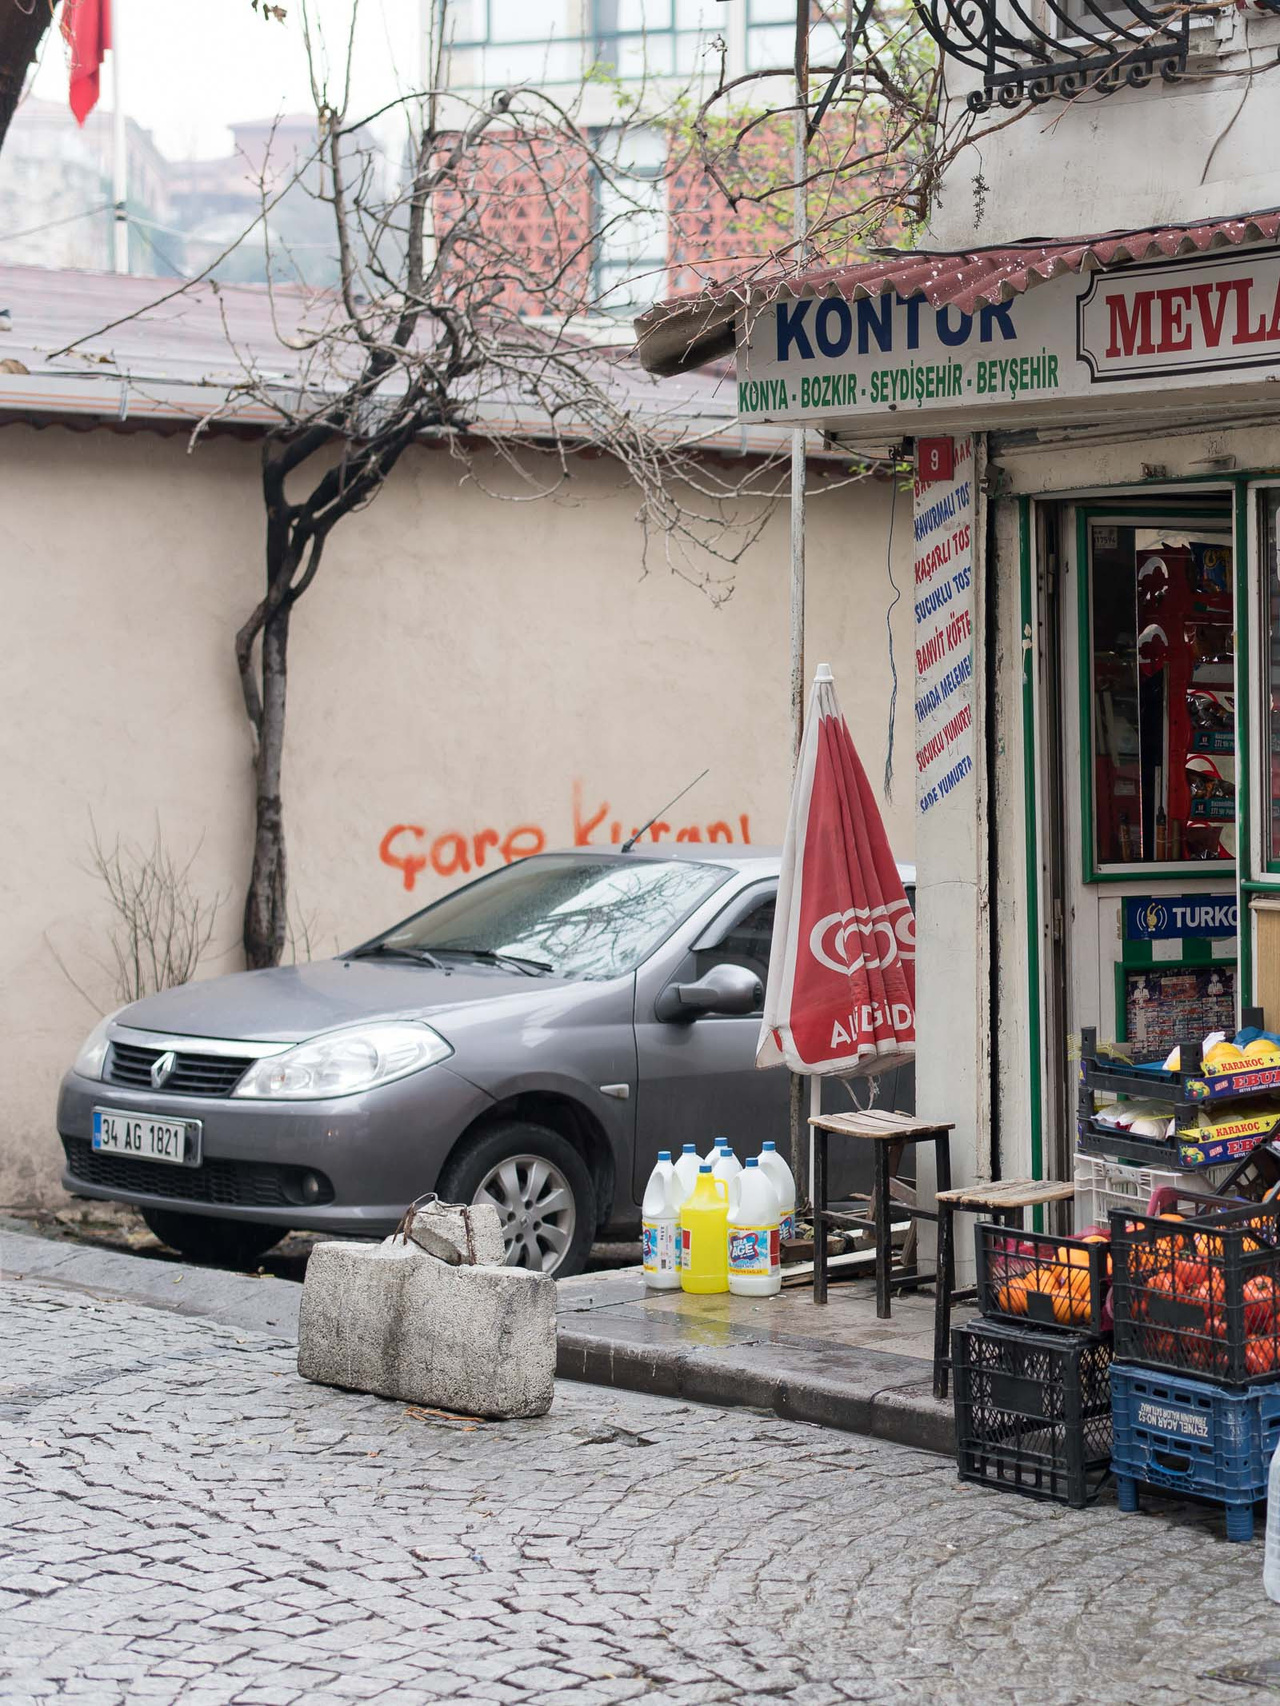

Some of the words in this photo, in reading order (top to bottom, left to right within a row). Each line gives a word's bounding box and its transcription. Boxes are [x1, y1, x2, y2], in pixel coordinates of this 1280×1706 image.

[739, 379, 788, 412] KONYA
[801, 372, 857, 408] BOZKIR
[870, 358, 963, 408] SEYDİŞEHİR
[977, 347, 1058, 399] BEYŞEHİR
[930, 449, 939, 471] 9
[914, 492, 956, 541] KAVURMALI
[956, 482, 971, 511] TOS
[914, 538, 951, 585] KAŞARLI
[952, 524, 971, 556] TOS
[915, 581, 953, 623] SUCUKLU
[915, 626, 946, 675] BANVİT
[914, 684, 943, 723] TAVADA
[915, 733, 945, 773] SUCUKLU
[920, 787, 939, 814] SADE
[1221, 1057, 1265, 1072] KARAKOÇ
[102, 1118, 118, 1147] 34
[124, 1123, 142, 1150] AG
[149, 1124, 179, 1158] 1821
[1216, 1121, 1260, 1137] KARAKOÇ
